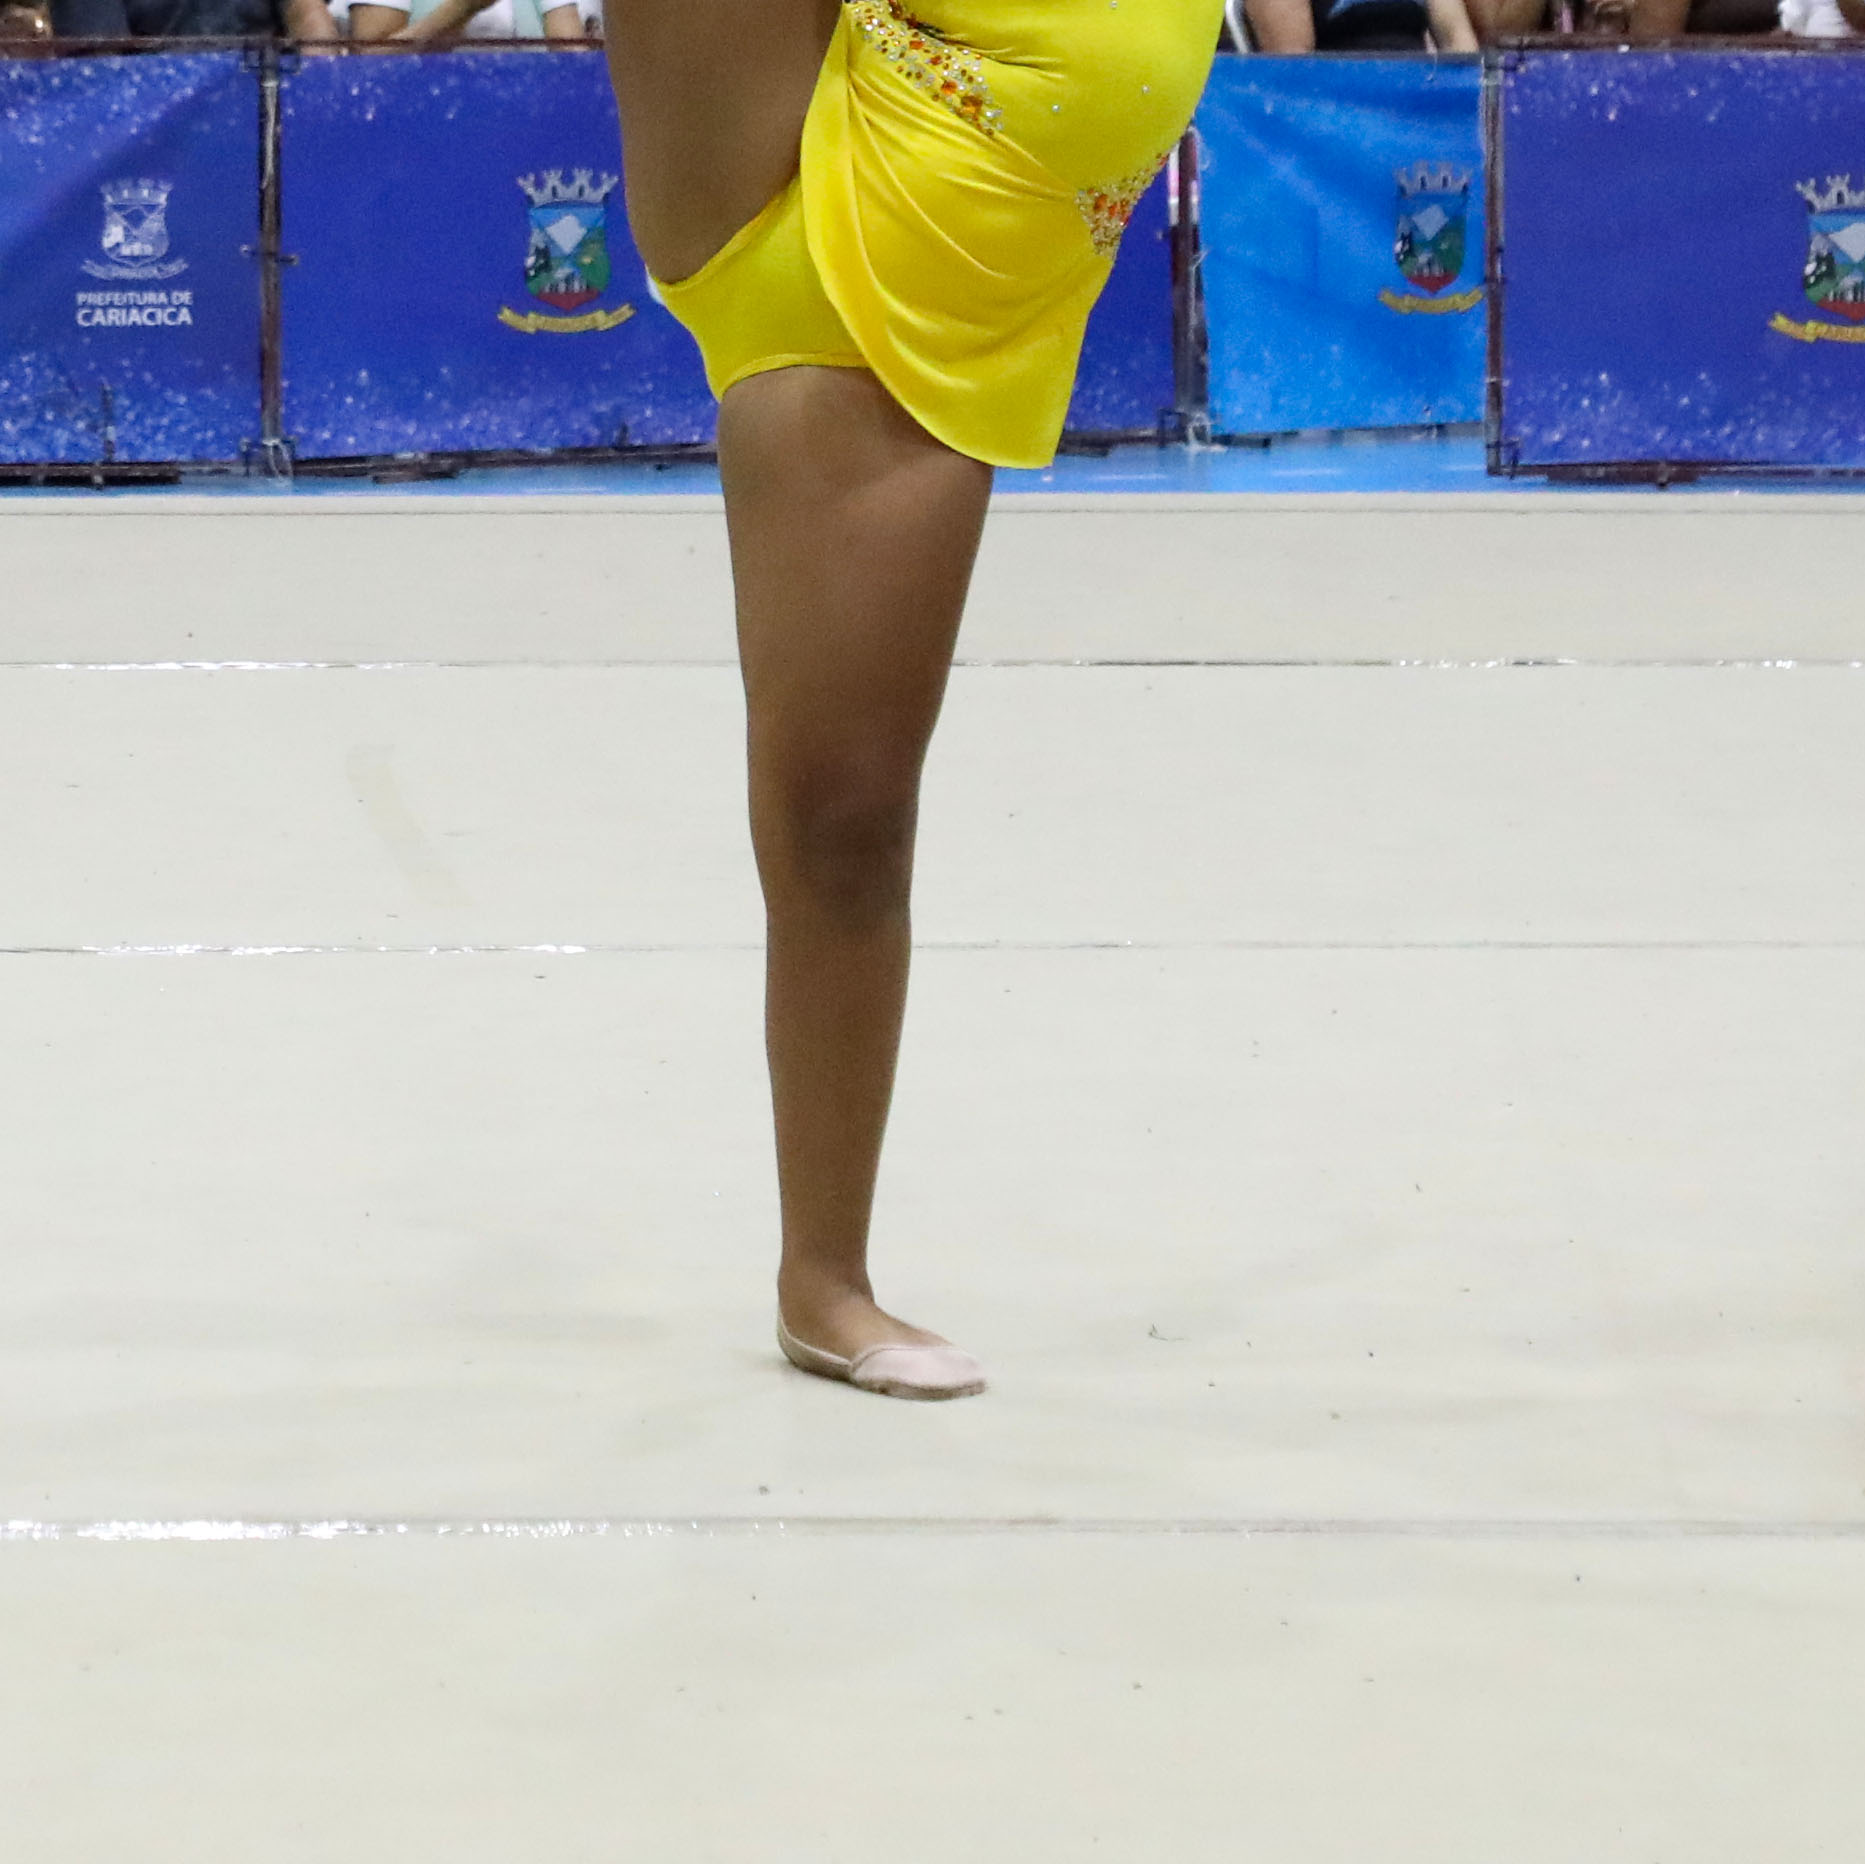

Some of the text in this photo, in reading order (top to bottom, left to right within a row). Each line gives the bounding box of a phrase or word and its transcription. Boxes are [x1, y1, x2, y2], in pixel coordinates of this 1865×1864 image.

[77, 292, 193, 306] PREFEITURA DE
[76, 307, 193, 327] CARIACICA
